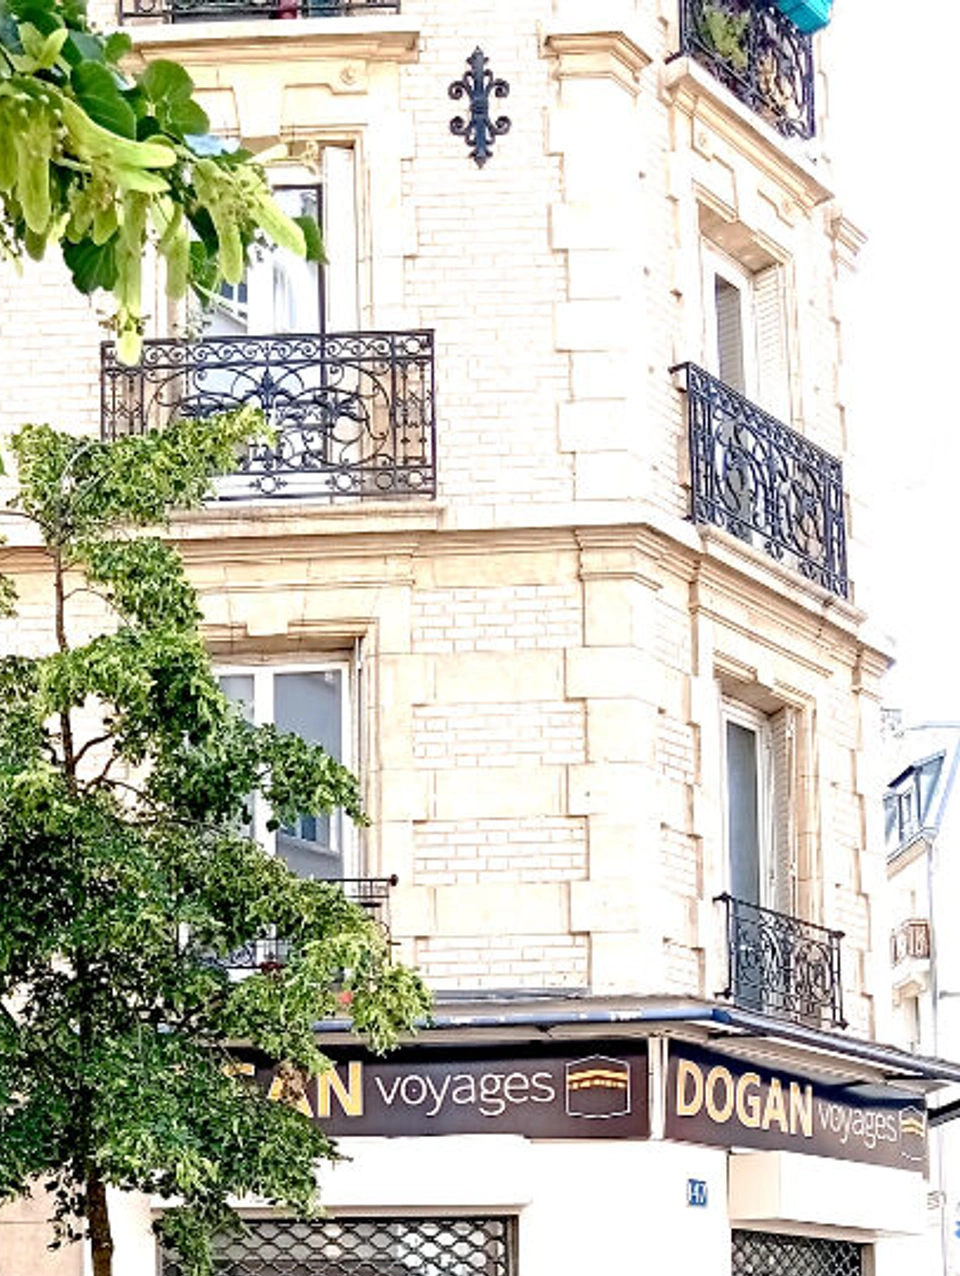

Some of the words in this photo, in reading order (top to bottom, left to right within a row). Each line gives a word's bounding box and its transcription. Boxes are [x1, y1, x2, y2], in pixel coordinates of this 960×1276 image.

[375, 1072, 555, 1115] voyages
[676, 1059, 813, 1137] DOGAN
[817, 1103, 898, 1148] voyages
